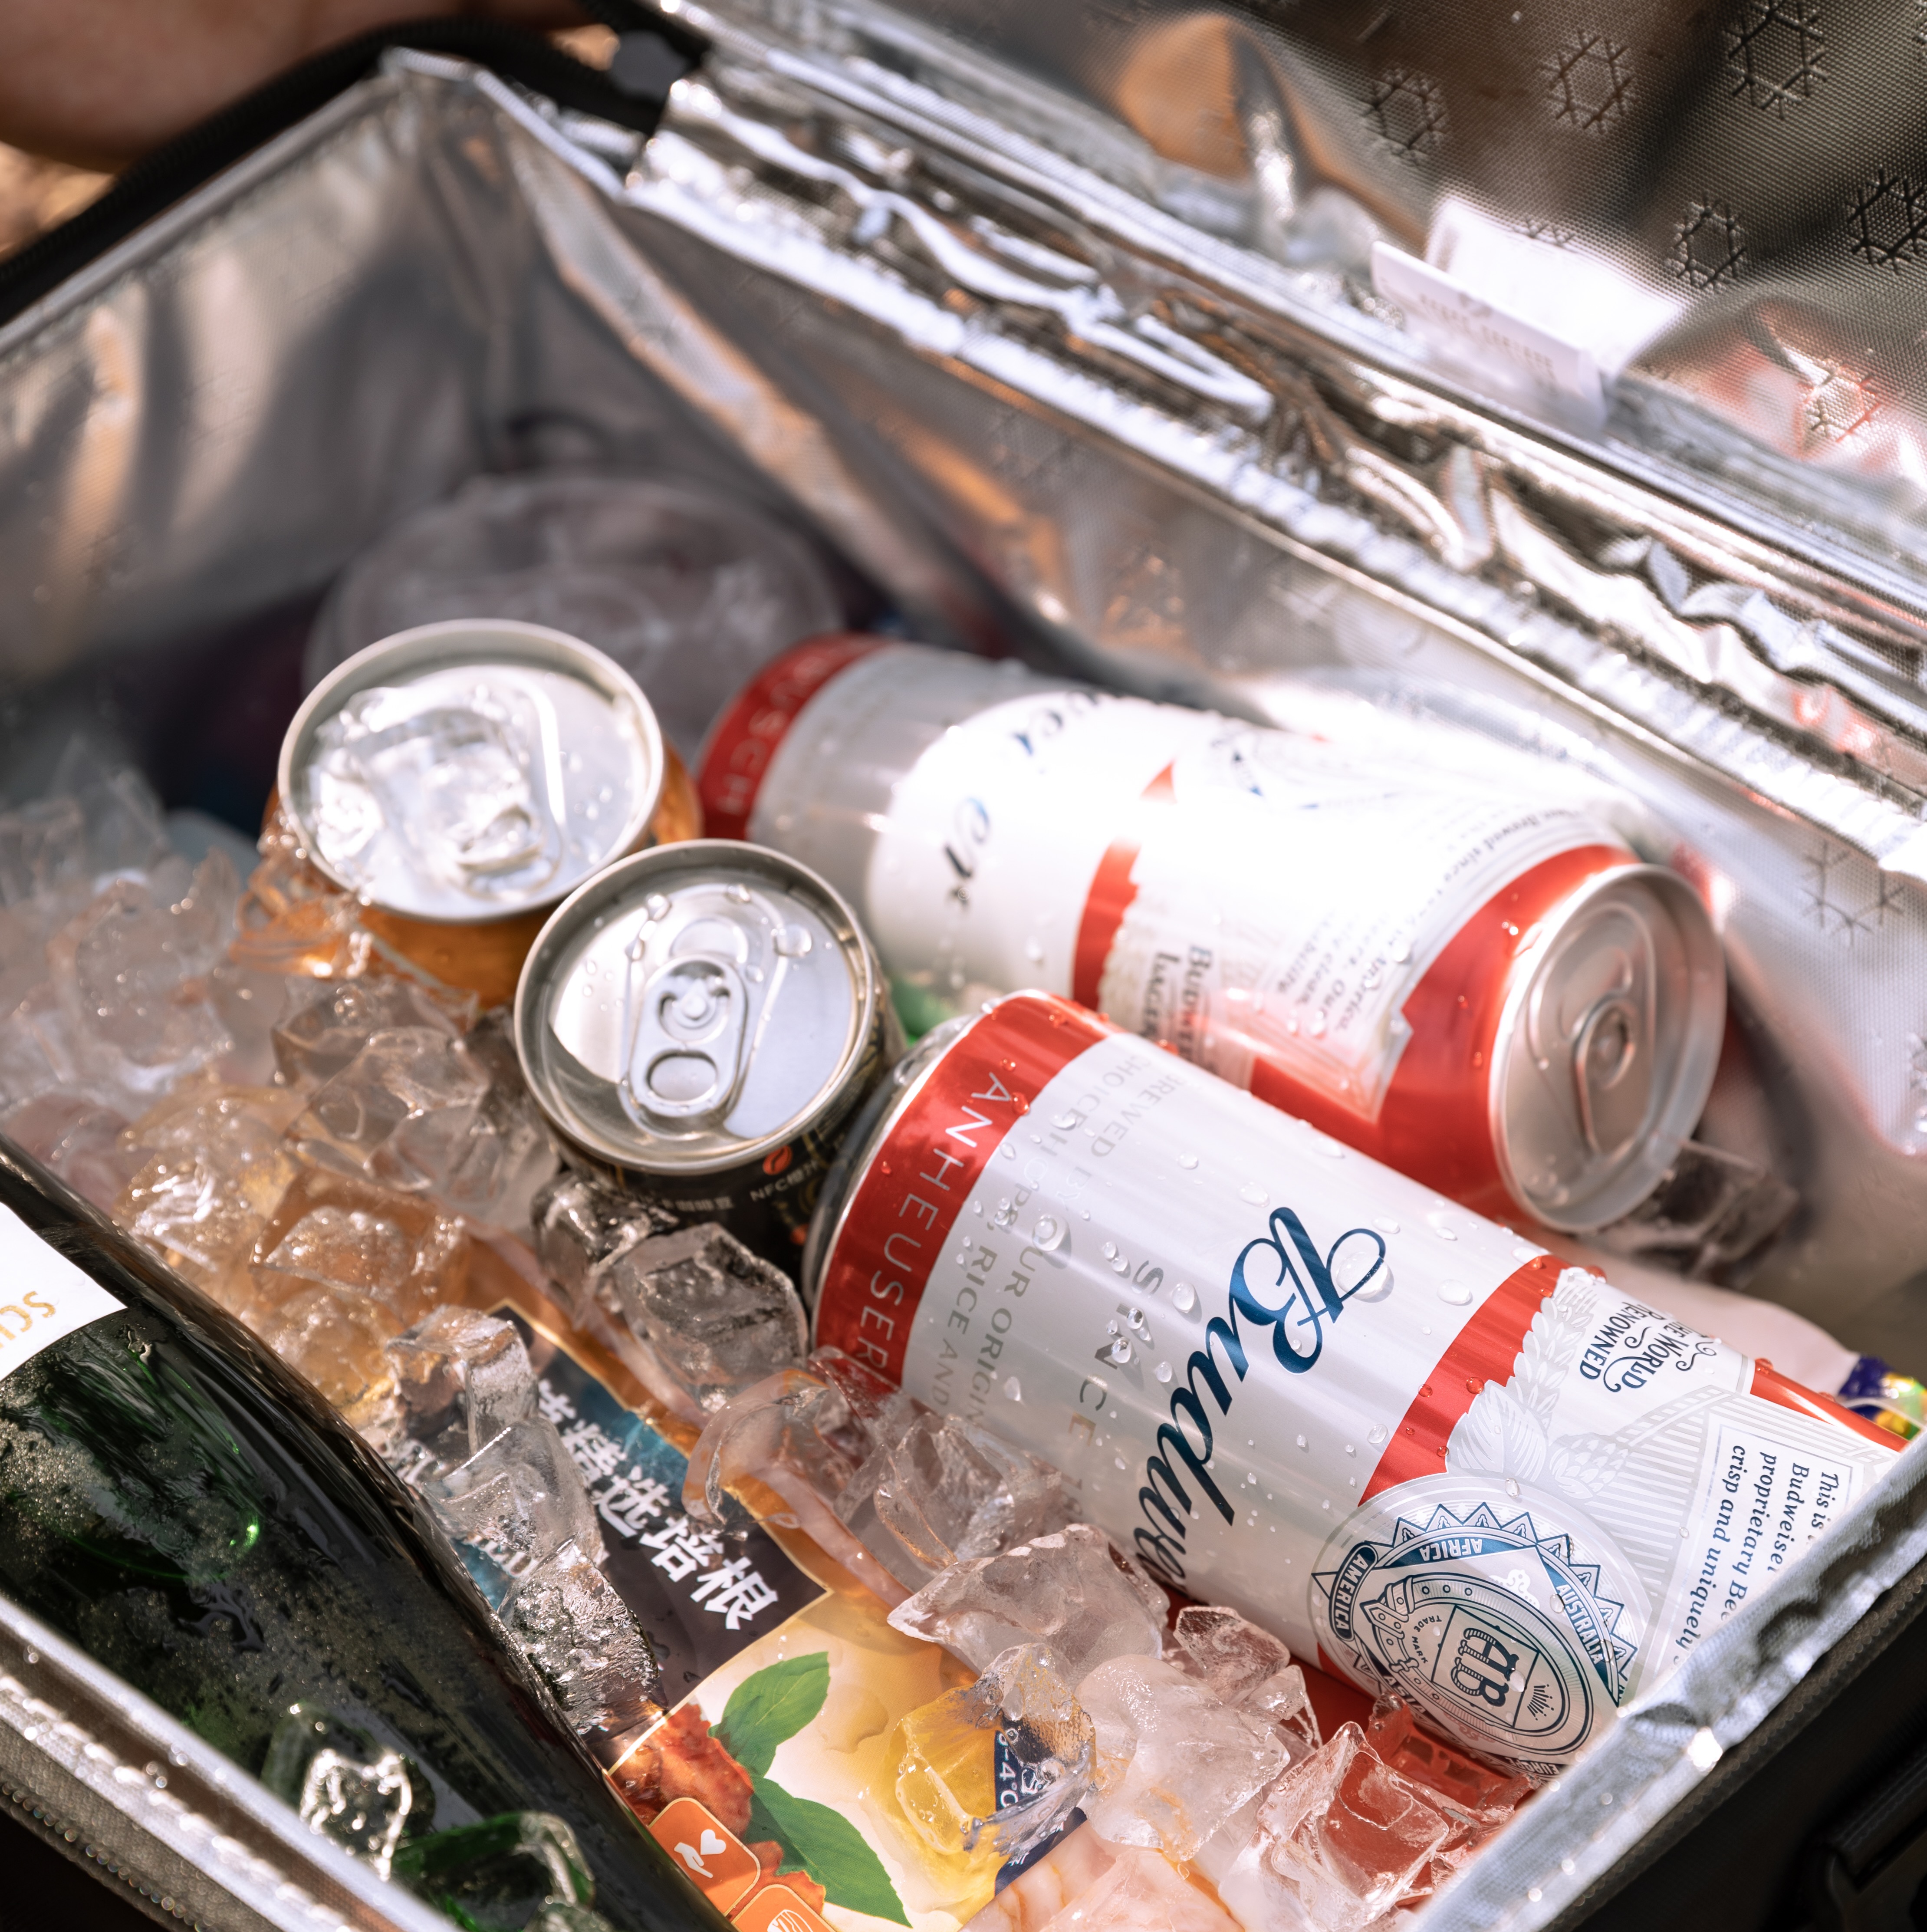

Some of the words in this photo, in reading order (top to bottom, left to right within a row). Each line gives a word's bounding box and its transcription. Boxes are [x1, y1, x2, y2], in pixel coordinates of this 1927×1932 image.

[1062, 1055, 1151, 1129] CHOICE
[1091, 1074, 1187, 1157] BREWED
[1056, 1166, 1092, 1211] BY
[856, 1072, 1011, 1369] ANHEUSER
[1004, 1217, 1057, 1297] OUR
[947, 1245, 997, 1335] RICE
[933, 1338, 958, 1405] AND
[1580, 1302, 1667, 1380] RENOWNED
[1603, 1333, 1690, 1392] WORLD
[1722, 1445, 1747, 1493] crisp
[1816, 1471, 1839, 1509] This
[1713, 1499, 1734, 1542] and
[1732, 1452, 1776, 1575] proprietary
[1811, 1512, 1831, 1530] is
[1419, 1538, 1483, 1561] AFRICA
[1335, 1553, 1368, 1630] AMERICA
[1675, 1548, 1720, 1650] uniquely
[1411, 1636, 1428, 1664] MARK
[1413, 1615, 1442, 1632] TRADE
[1556, 1585, 1603, 1665] AUSTRALIA
[1384, 1675, 1427, 1714] ASIA
[1505, 1757, 1559, 1775] EUROPE
